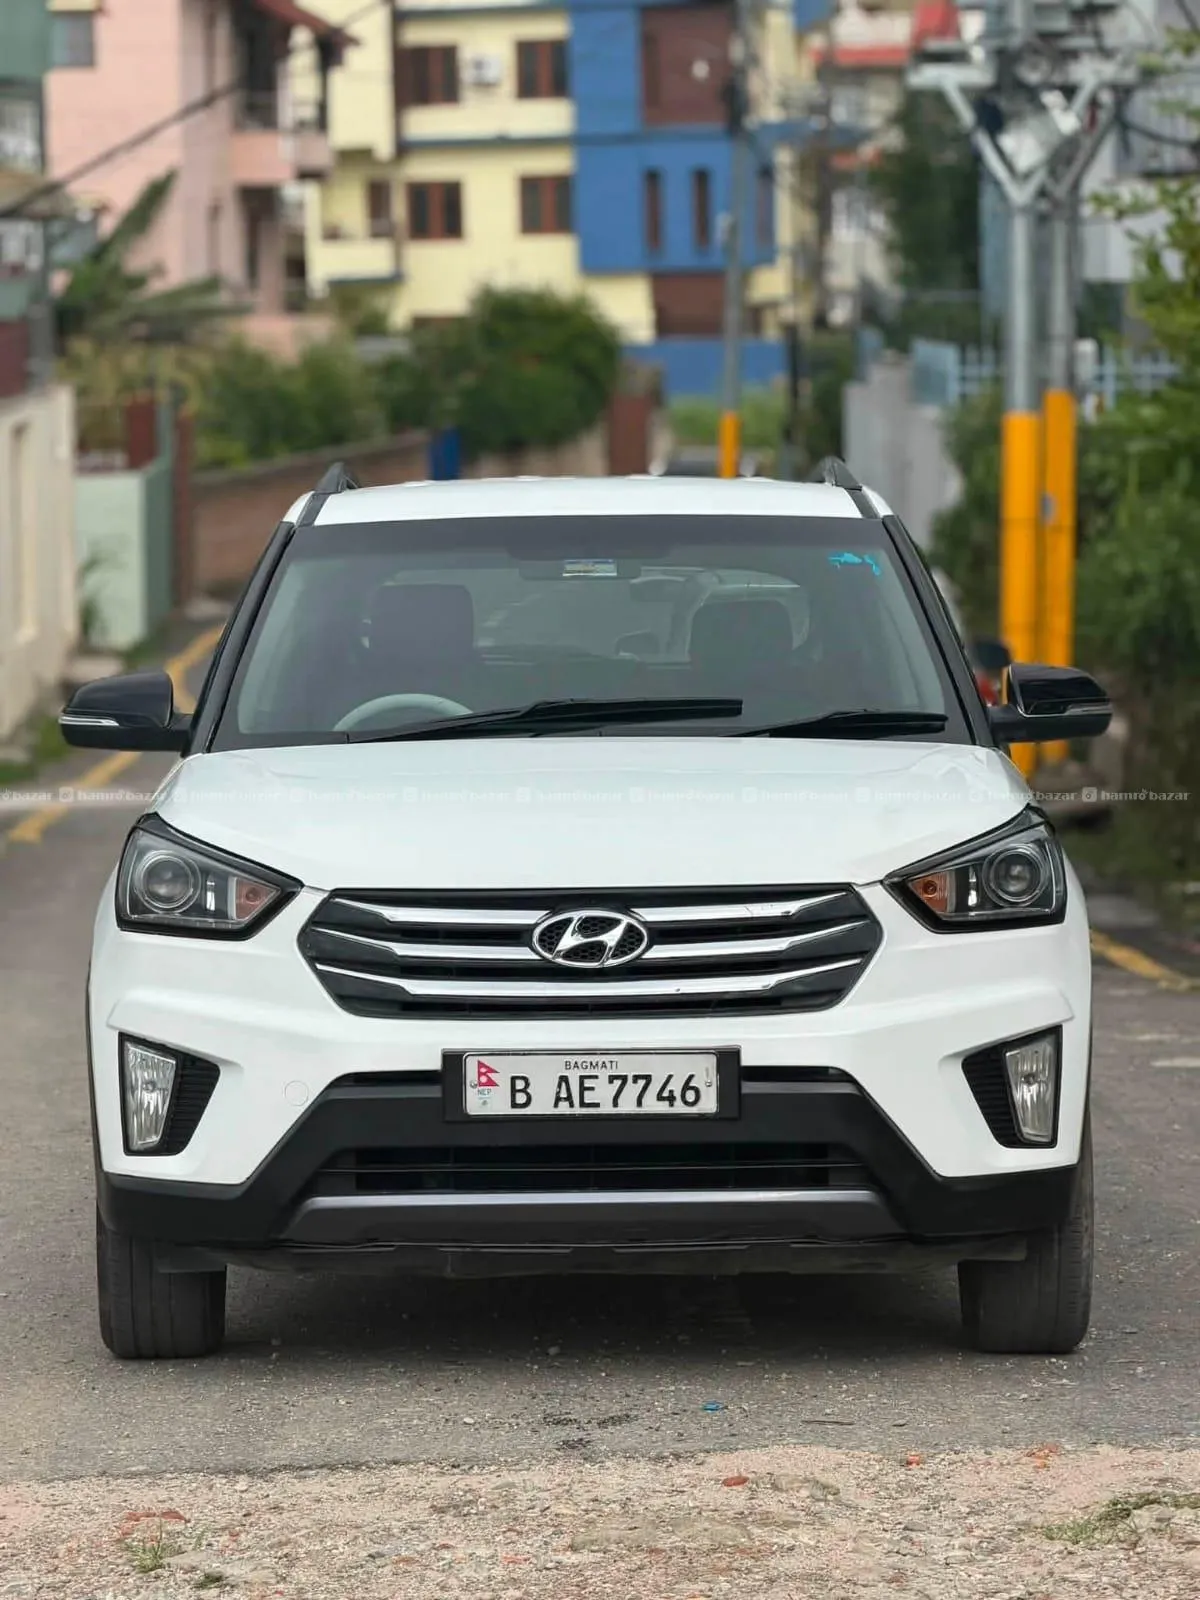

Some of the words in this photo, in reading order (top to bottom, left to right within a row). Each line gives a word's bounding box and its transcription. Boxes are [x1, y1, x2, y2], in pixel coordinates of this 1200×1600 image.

[564, 1060, 619, 1071] BAGMATI
[477, 1088, 492, 1096] NEP
[509, 1075, 532, 1109] B
